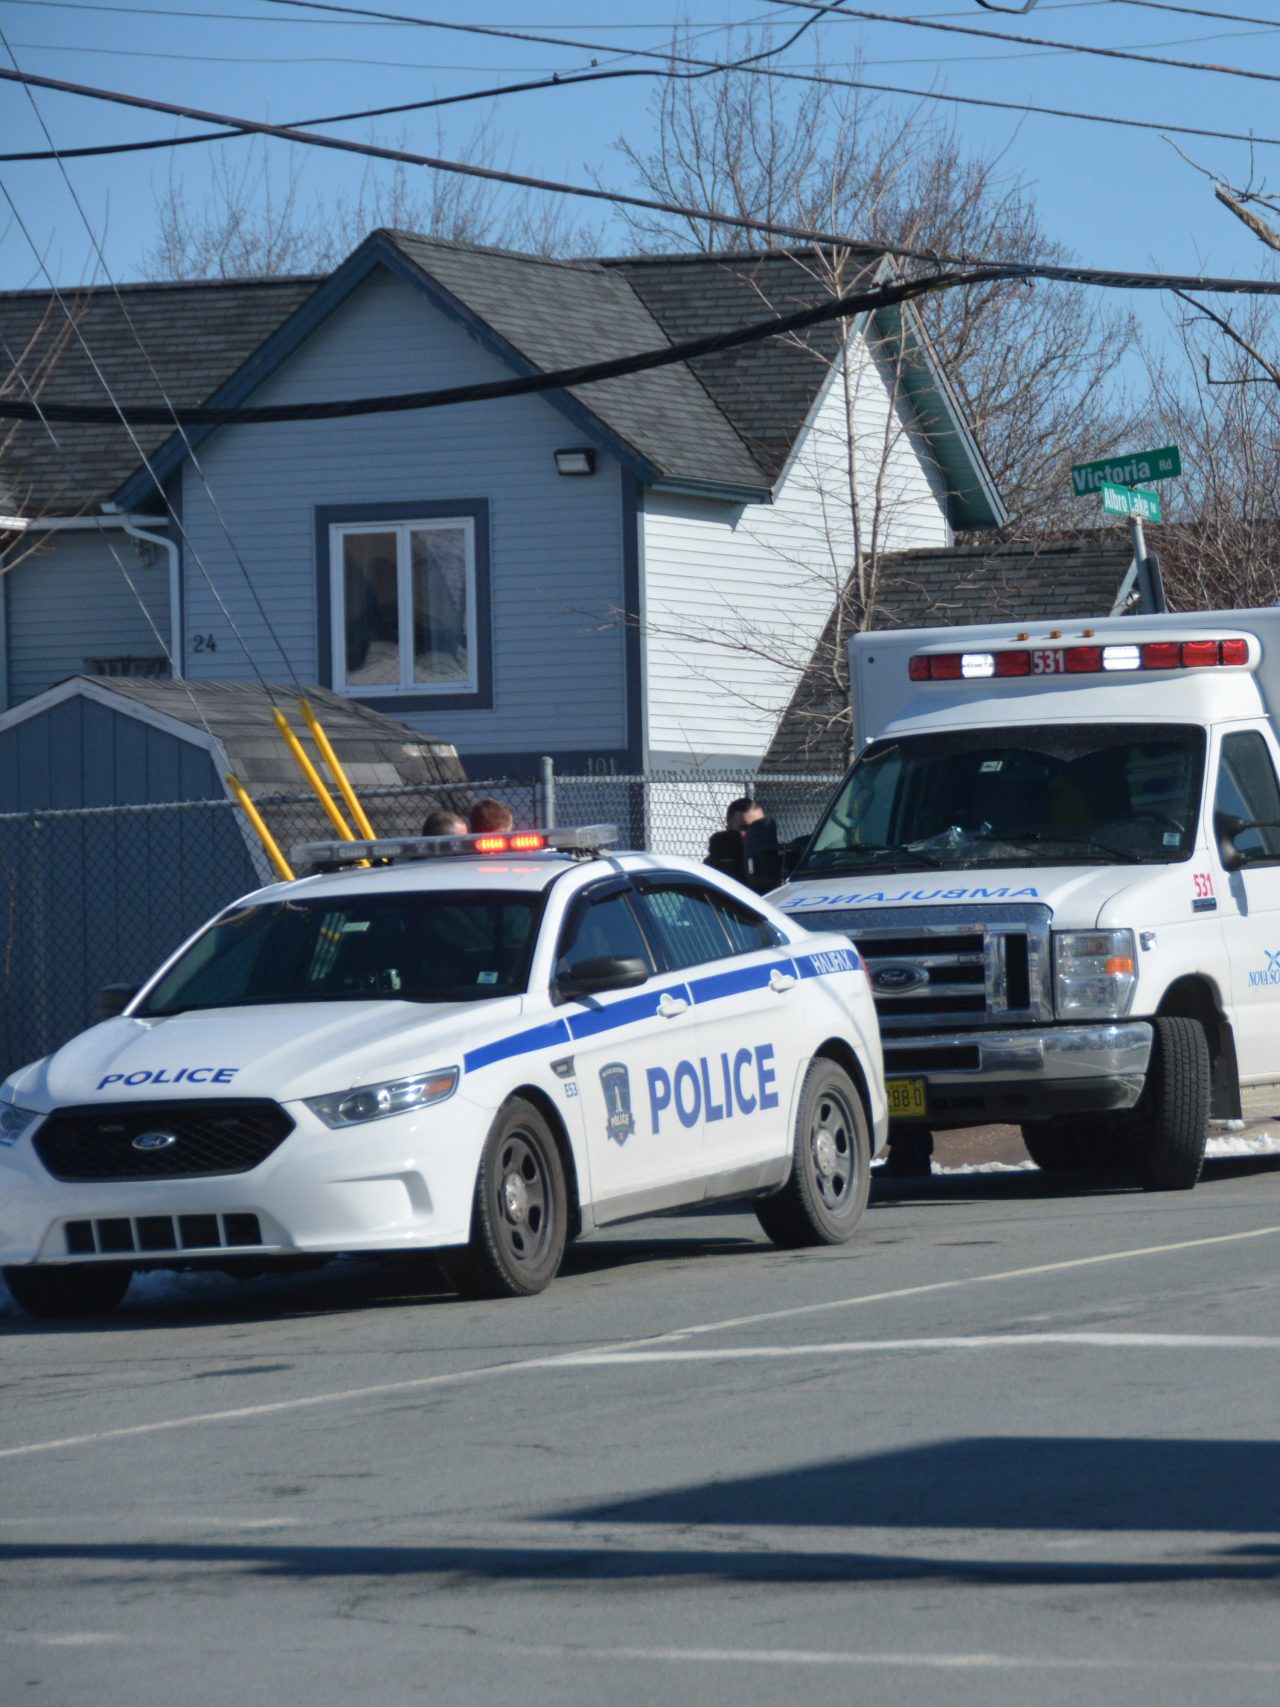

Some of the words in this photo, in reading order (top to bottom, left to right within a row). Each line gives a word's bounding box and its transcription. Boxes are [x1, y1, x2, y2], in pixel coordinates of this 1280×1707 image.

[1073, 459, 1151, 491] Victoria
[1159, 458, 1173, 471] Rd
[1104, 487, 1128, 512] Albro
[193, 634, 216, 653] 24
[1033, 650, 1065, 675] 531
[1193, 873, 1214, 897] 531
[809, 950, 853, 974] HALIFAX
[1248, 970, 1269, 987] NOVA
[96, 1068, 240, 1090] POLICE
[646, 1043, 779, 1135] POLICE
[610, 1113, 629, 1128] POLICE
